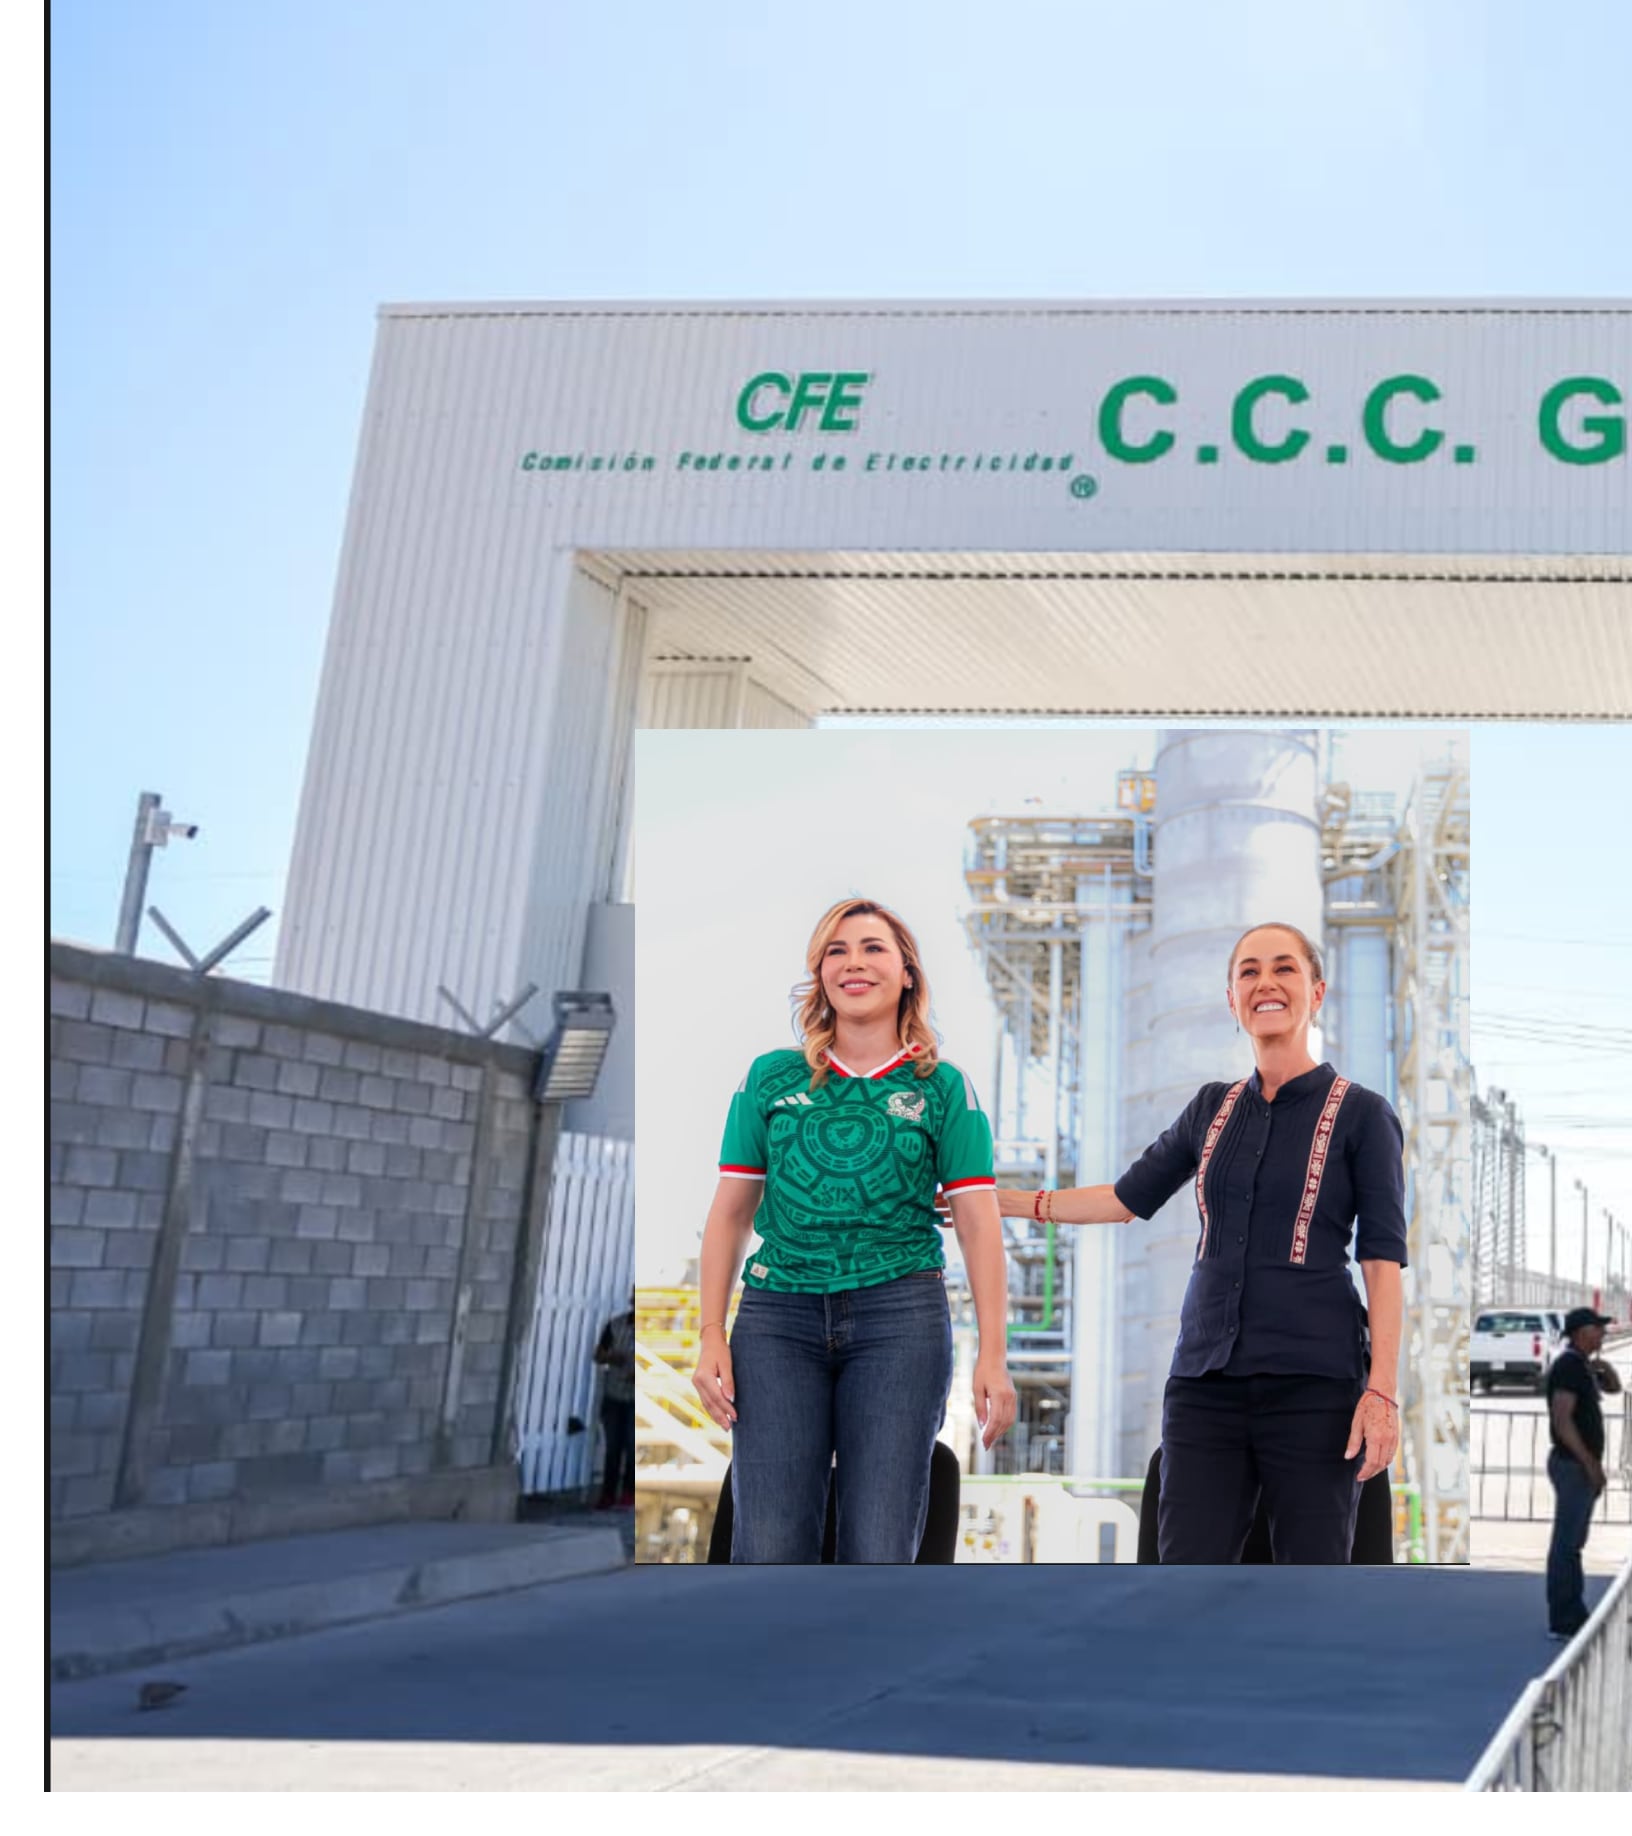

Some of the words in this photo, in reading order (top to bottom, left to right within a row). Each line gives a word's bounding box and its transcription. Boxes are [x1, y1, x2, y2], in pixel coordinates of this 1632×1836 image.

[736, 371, 870, 433] CFE
[1097, 374, 1476, 464] C.C.C.
[521, 451, 656, 471] Comisión
[676, 452, 791, 471] Federal
[811, 454, 847, 471] de
[864, 453, 1073, 471] Electricidad
